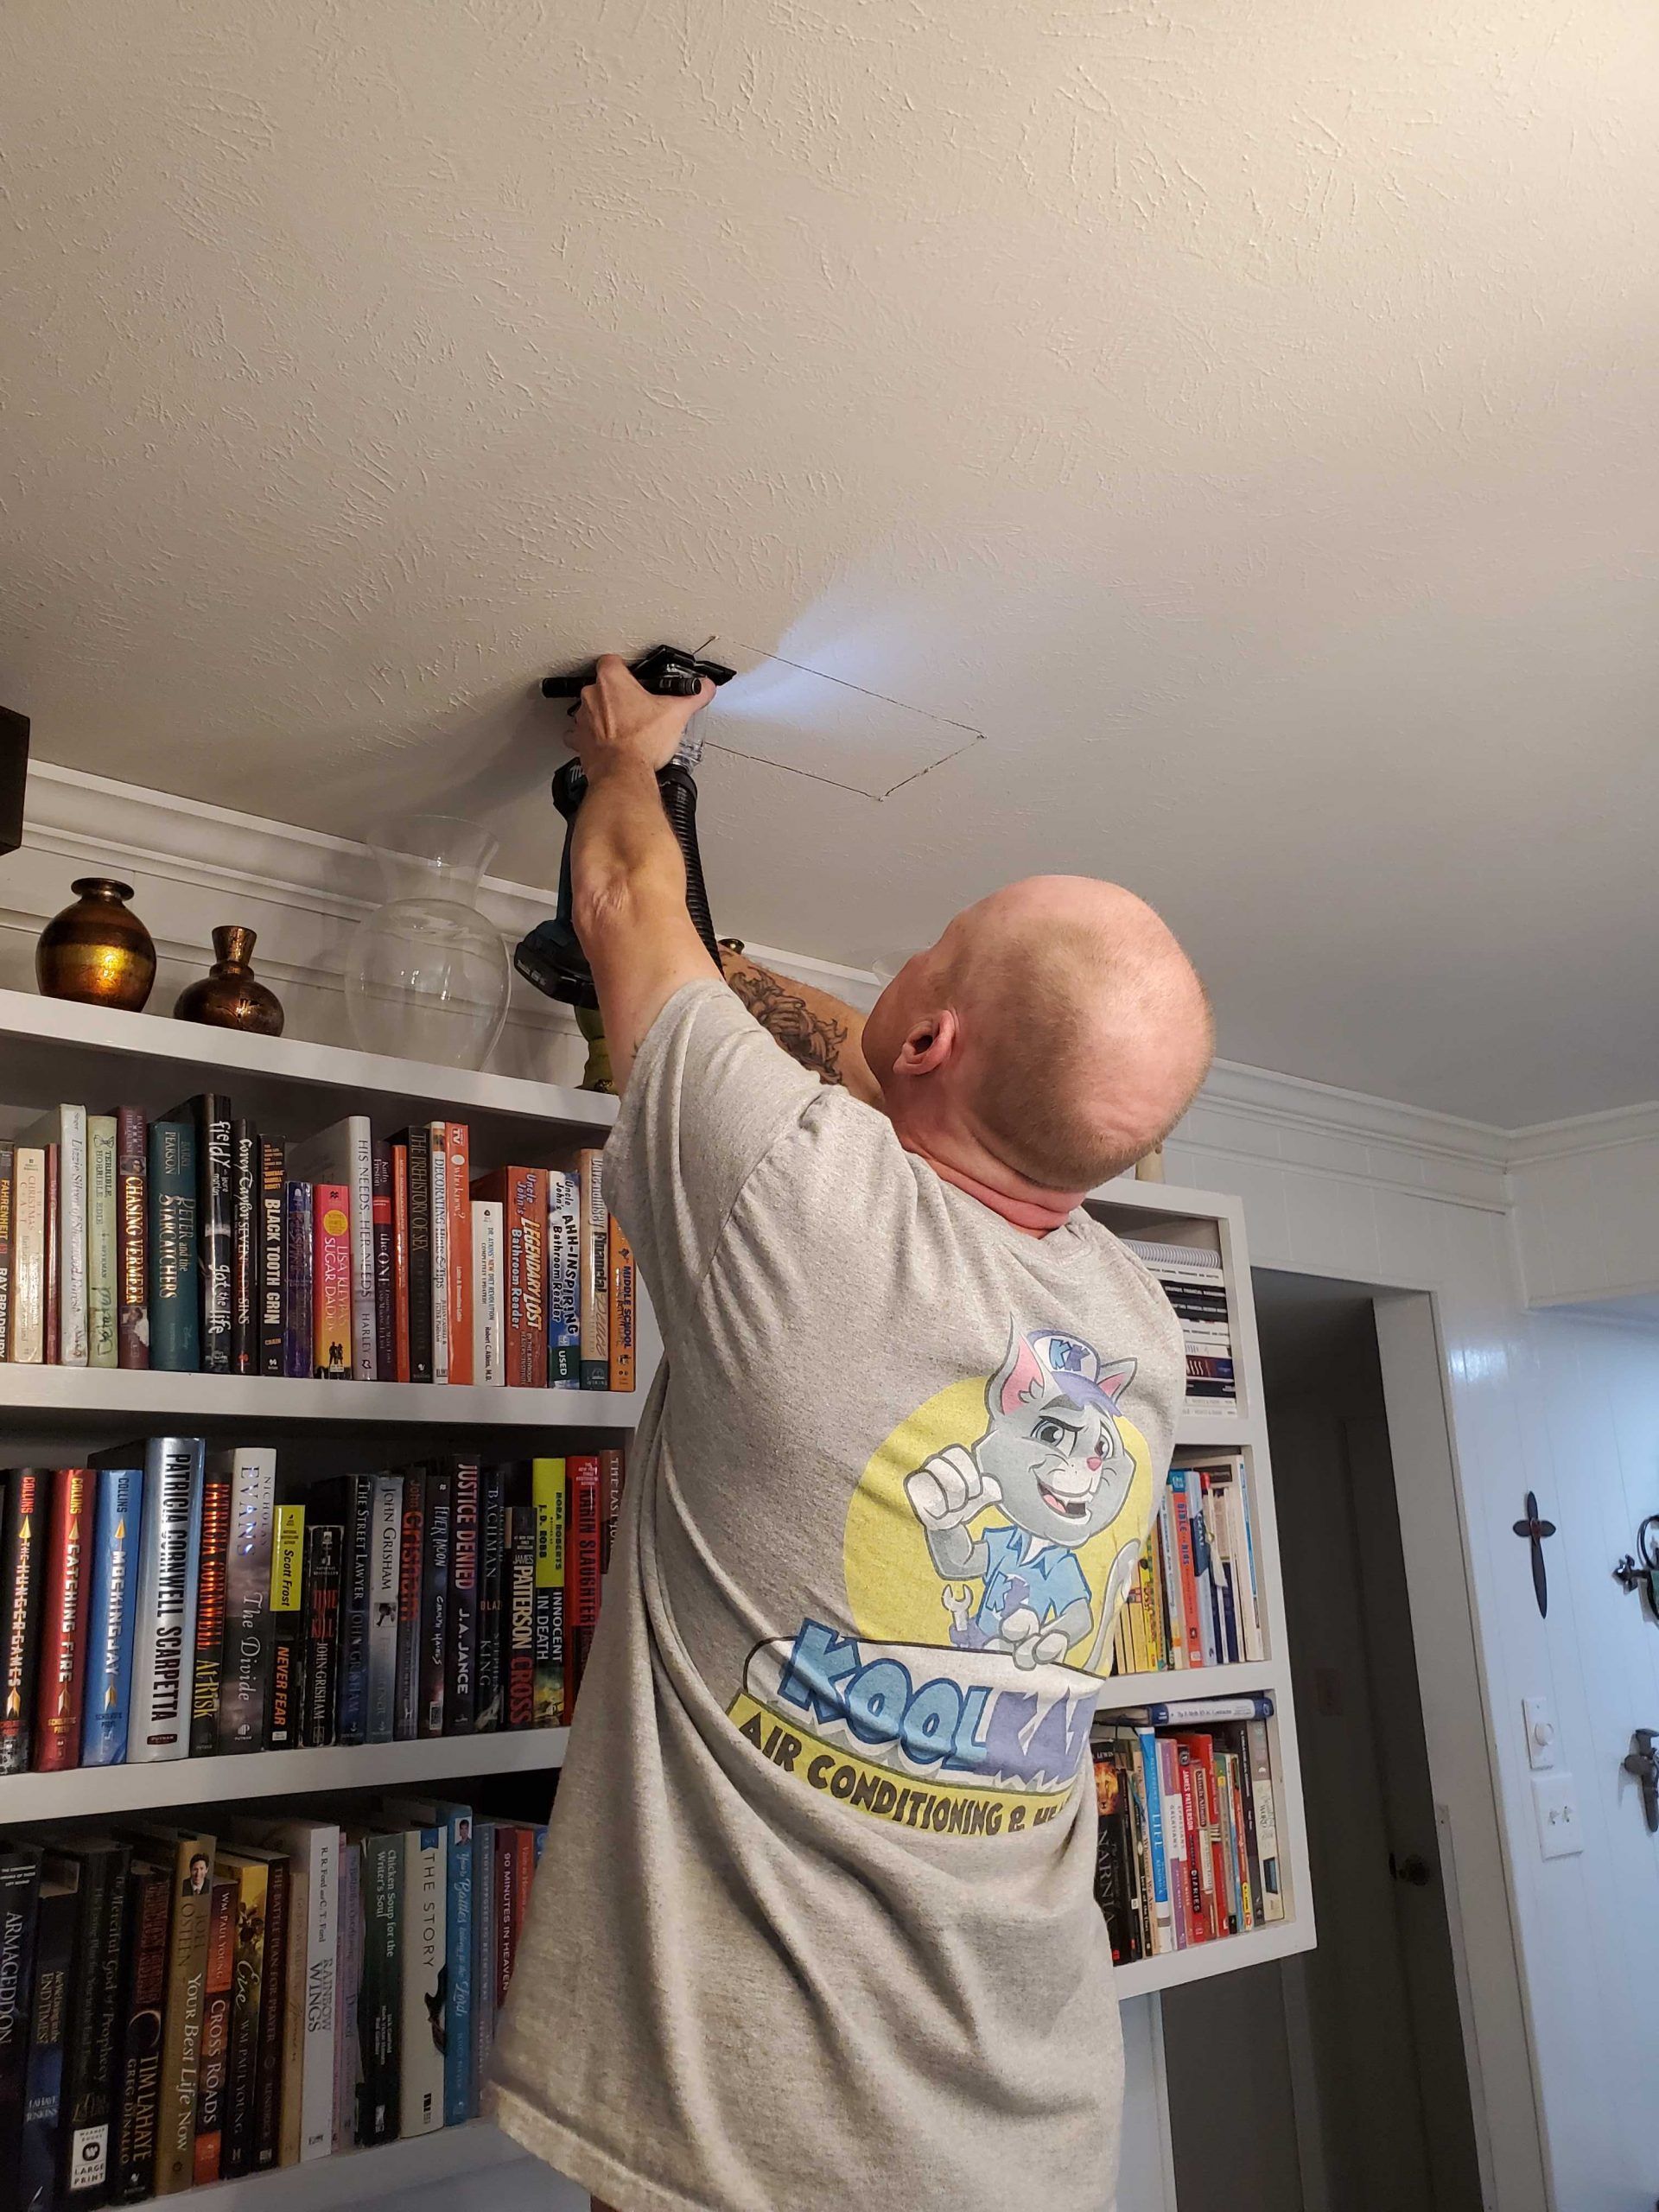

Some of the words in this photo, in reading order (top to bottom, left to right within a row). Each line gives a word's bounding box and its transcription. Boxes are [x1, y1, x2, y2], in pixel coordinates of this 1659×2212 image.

[165, 1131, 175, 1176] PEARSON
[234, 1139, 251, 1173] Corey
[358, 1139, 369, 1162] HIS
[412, 1134, 425, 1154] THE
[453, 1128, 461, 1144] TV
[126, 1177, 143, 1236] CHASING
[233, 1173, 251, 1220] Taylor
[359, 1167, 370, 1214] NEEDS,
[412, 1156, 427, 1216] PREHISTORY
[435, 1158, 445, 1224] DECORATING
[517, 1180, 526, 1215] John's
[525, 1174, 537, 1204] Uncle
[555, 1181, 564, 1211] John's
[564, 1180, 574, 1206] Uncle
[0, 1179, 10, 1241] FAHRENHEIT
[177, 1198, 195, 1239] PETER
[264, 1198, 281, 1241] BLACK
[413, 1217, 428, 1232] OF
[158, 1193, 177, 1299] STARCATCHERS
[179, 1242, 188, 1255] and
[359, 1220, 370, 1246] HER
[378, 1233, 388, 1251] the
[413, 1234, 428, 1252] SEX
[552, 1225, 563, 1279] Bathroom
[125, 1238, 143, 1305] VERMEER
[179, 1258, 188, 1272] the
[208, 1264, 230, 1287] got
[266, 1246, 280, 1287] TOOTH
[324, 1237, 335, 1282] SUGAR
[336, 1245, 347, 1271] LISA
[360, 1250, 371, 1298] NEEDS
[377, 1252, 389, 1287] ONE
[511, 1228, 522, 1285] Bathroom
[521, 1217, 540, 1299] LEGENDARY
[594, 1231, 607, 1294] Financial
[433, 1267, 446, 1289] Tips
[623, 1265, 632, 1306] MIDDLE
[208, 1310, 231, 1334] life
[264, 1292, 280, 1325] GRIN
[325, 1286, 335, 1332] DADDY
[511, 1287, 521, 1330] Reader
[523, 1296, 542, 1331] LOST
[552, 1282, 562, 1323] Reader
[361, 1313, 371, 1354] HARLEY
[594, 1294, 607, 1357] Peace
[623, 1308, 632, 1349] SCHOOL
[558, 1350, 567, 1376] USED
[162, 1452, 191, 1523] PATRICIA
[609, 1458, 619, 1485] THE
[21, 1476, 35, 1515] COLLINS
[69, 1478, 83, 1515] COLLINS
[117, 1477, 129, 1513] COLLINS
[237, 1465, 259, 1556] EVANS
[261, 1476, 271, 1547] NICHOLAS
[357, 1481, 370, 1505] THE
[380, 1487, 396, 1522] JOHN
[409, 1479, 420, 1508] John
[456, 1463, 477, 1523] JUSTICE
[579, 1488, 595, 1535] KARIN
[203, 1484, 230, 1556] PATRICIA
[355, 1509, 368, 1548] STREET
[430, 1506, 449, 1535] FEVER
[486, 1487, 499, 1578] BACHMAN
[1177, 1503, 1188, 1532] BIBLE
[19, 1541, 30, 1560] THE
[283, 1548, 294, 1578] Scott
[381, 1527, 397, 1590] GRISHAM
[432, 1538, 448, 1567] MOON
[454, 1530, 475, 1590] DENIED
[538, 1530, 547, 1558] ROBB
[156, 1529, 186, 1618] CORNWELL
[353, 1553, 367, 1600] LAWYER
[400, 1510, 423, 1622] Grisham
[578, 1539, 595, 1623] SLAUGHTER
[12, 1565, 30, 1630] HUNGER
[61, 1543, 79, 1633] CATCHING
[197, 1560, 224, 1650] CORNWELL
[281, 1579, 292, 1606] Frost
[511, 1565, 533, 1649] PATTERSON
[537, 1595, 549, 1609] IN
[105, 1550, 126, 1675] MOCKINGJAY
[242, 1592, 263, 1628] The
[346, 1610, 369, 1644] JOHN
[552, 1591, 563, 1662] INNOCENT
[315, 1643, 327, 1669] JOHN
[537, 1614, 549, 1660] DEATH
[8, 1635, 23, 1687] GAMES
[58, 1641, 74, 1683] FIRE
[151, 1626, 181, 1721] SCARPETTA
[238, 1636, 260, 1700] Divide
[275, 1646, 289, 1688] NEVER
[456, 1642, 469, 1694] JANCE
[479, 1640, 491, 1687] KING
[194, 1677, 218, 1719] Risk
[274, 1692, 288, 1726] FEAR
[313, 1671, 327, 1719] GRISHAM
[509, 1656, 533, 1725] CROSS
[778, 1617, 994, 1771] KOOL
[739, 1712, 803, 1772] AIR
[807, 1756, 1003, 1836] CONDITIONING
[1007, 1805, 1026, 1833] &
[1182, 1770, 1191, 1792] JAMES
[1184, 1793, 1194, 1831] PATTERSON
[376, 1851, 386, 1892] Writer's
[385, 1849, 397, 1890] Chicken
[423, 1853, 435, 1891] THE
[502, 1853, 511, 1869] 90
[1096, 1828, 1116, 1923] NARNIA
[375, 1894, 388, 1917] Soul
[383, 1892, 396, 1919] Soup
[502, 1872, 512, 1924] MINUTES
[1191, 1869, 1200, 1911] DIARIES
[177, 1904, 194, 1966] OSTEEN
[195, 1912, 207, 1948] JOEL
[217, 1915, 228, 1941] PAUL
[385, 1922, 396, 1938] for
[385, 1939, 396, 1957] the
[423, 1902, 435, 1967] STORY
[502, 1928, 512, 1941] IN
[0, 1910, 23, 2044] ARMAGEDDON
[215, 1942, 226, 1980] YOUNG
[501, 1943, 511, 1992] HEAVEN
[39, 1974, 53, 1999] END
[235, 1960, 258, 2011] Eve
[307, 1961, 322, 2033] WINGS
[321, 1958, 333, 2032] RAINBOW
[207, 1999, 226, 2056] CROSS
[125, 2058, 137, 2097] GREG
[138, 2052, 158, 2090] TIM
[236, 2049, 248, 2082] PAUL
[203, 2063, 222, 2124] ROADS
[233, 2084, 246, 2134] YOUNG
[132, 2092, 156, 2162] LAHAYE
[74, 2164, 104, 2176] LARGE
[74, 2174, 105, 2185] PRINT
